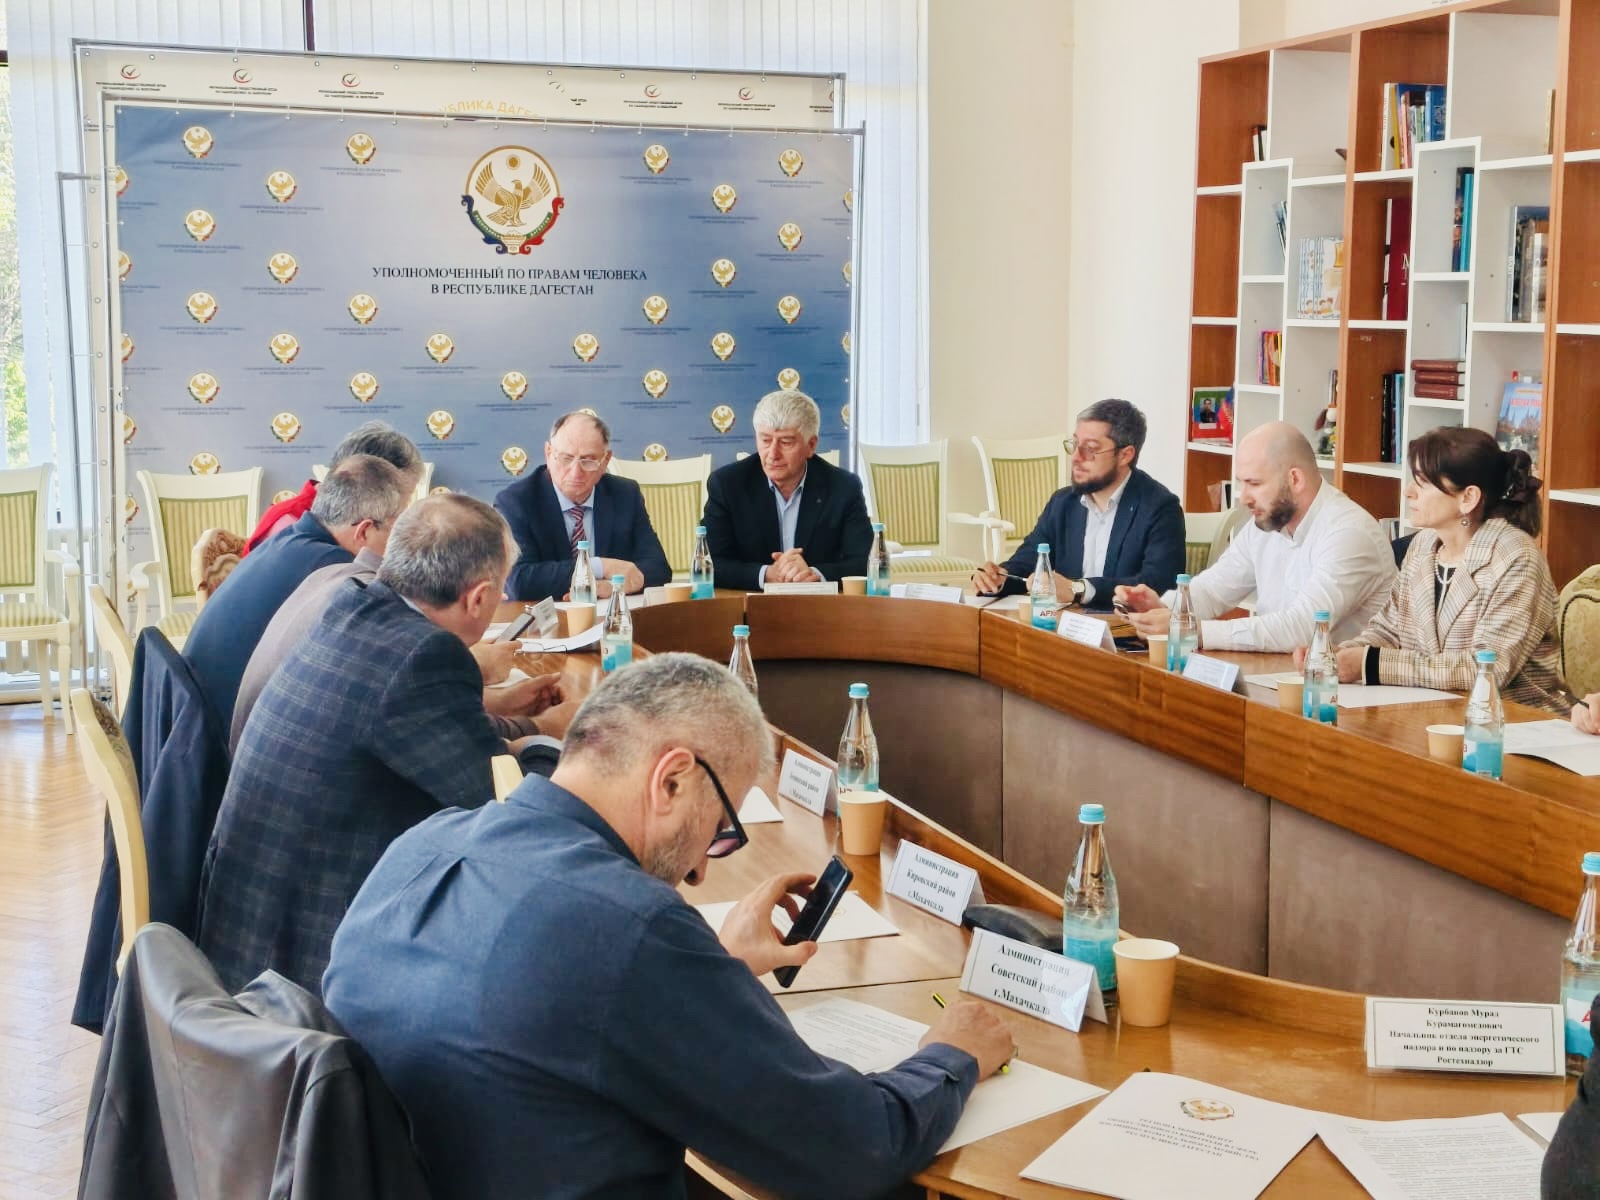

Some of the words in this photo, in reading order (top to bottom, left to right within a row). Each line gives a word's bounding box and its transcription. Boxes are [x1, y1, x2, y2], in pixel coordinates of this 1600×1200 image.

[372, 266, 504, 279] УПОЛНОМОЧЕННЫЙ
[507, 269, 525, 279] ПО
[528, 269, 580, 280] ПРАВАМ
[583, 269, 647, 281] ЧЕЛОВЕКА
[431, 284, 439, 294] В
[443, 283, 527, 295] РЕСПУБЛИКЕ
[530, 284, 594, 296] ДАГЕСТАН
[915, 853, 959, 879] Администрация
[907, 868, 938, 889] Кировский
[938, 885, 956, 898] район
[908, 890, 944, 913] г.Махачкала
[999, 943, 1071, 977] Администрация
[991, 962, 1037, 988] Советский
[1039, 981, 1068, 999] район
[994, 988, 1051, 1015] г.Махачкала
[1428, 1007, 1469, 1018] Курбанов
[1471, 1009, 1500, 1019] Мурад
[1389, 1030, 1437, 1040] Начальник
[1439, 1033, 1468, 1042] отдела
[1470, 1034, 1540, 1044] энергетического
[1403, 1044, 1437, 1053] надзора
[1458, 1047, 1492, 1055] надзору
[1504, 1047, 1525, 1055] ГТС
[1437, 1055, 1494, 1067] Ростехнадзор
